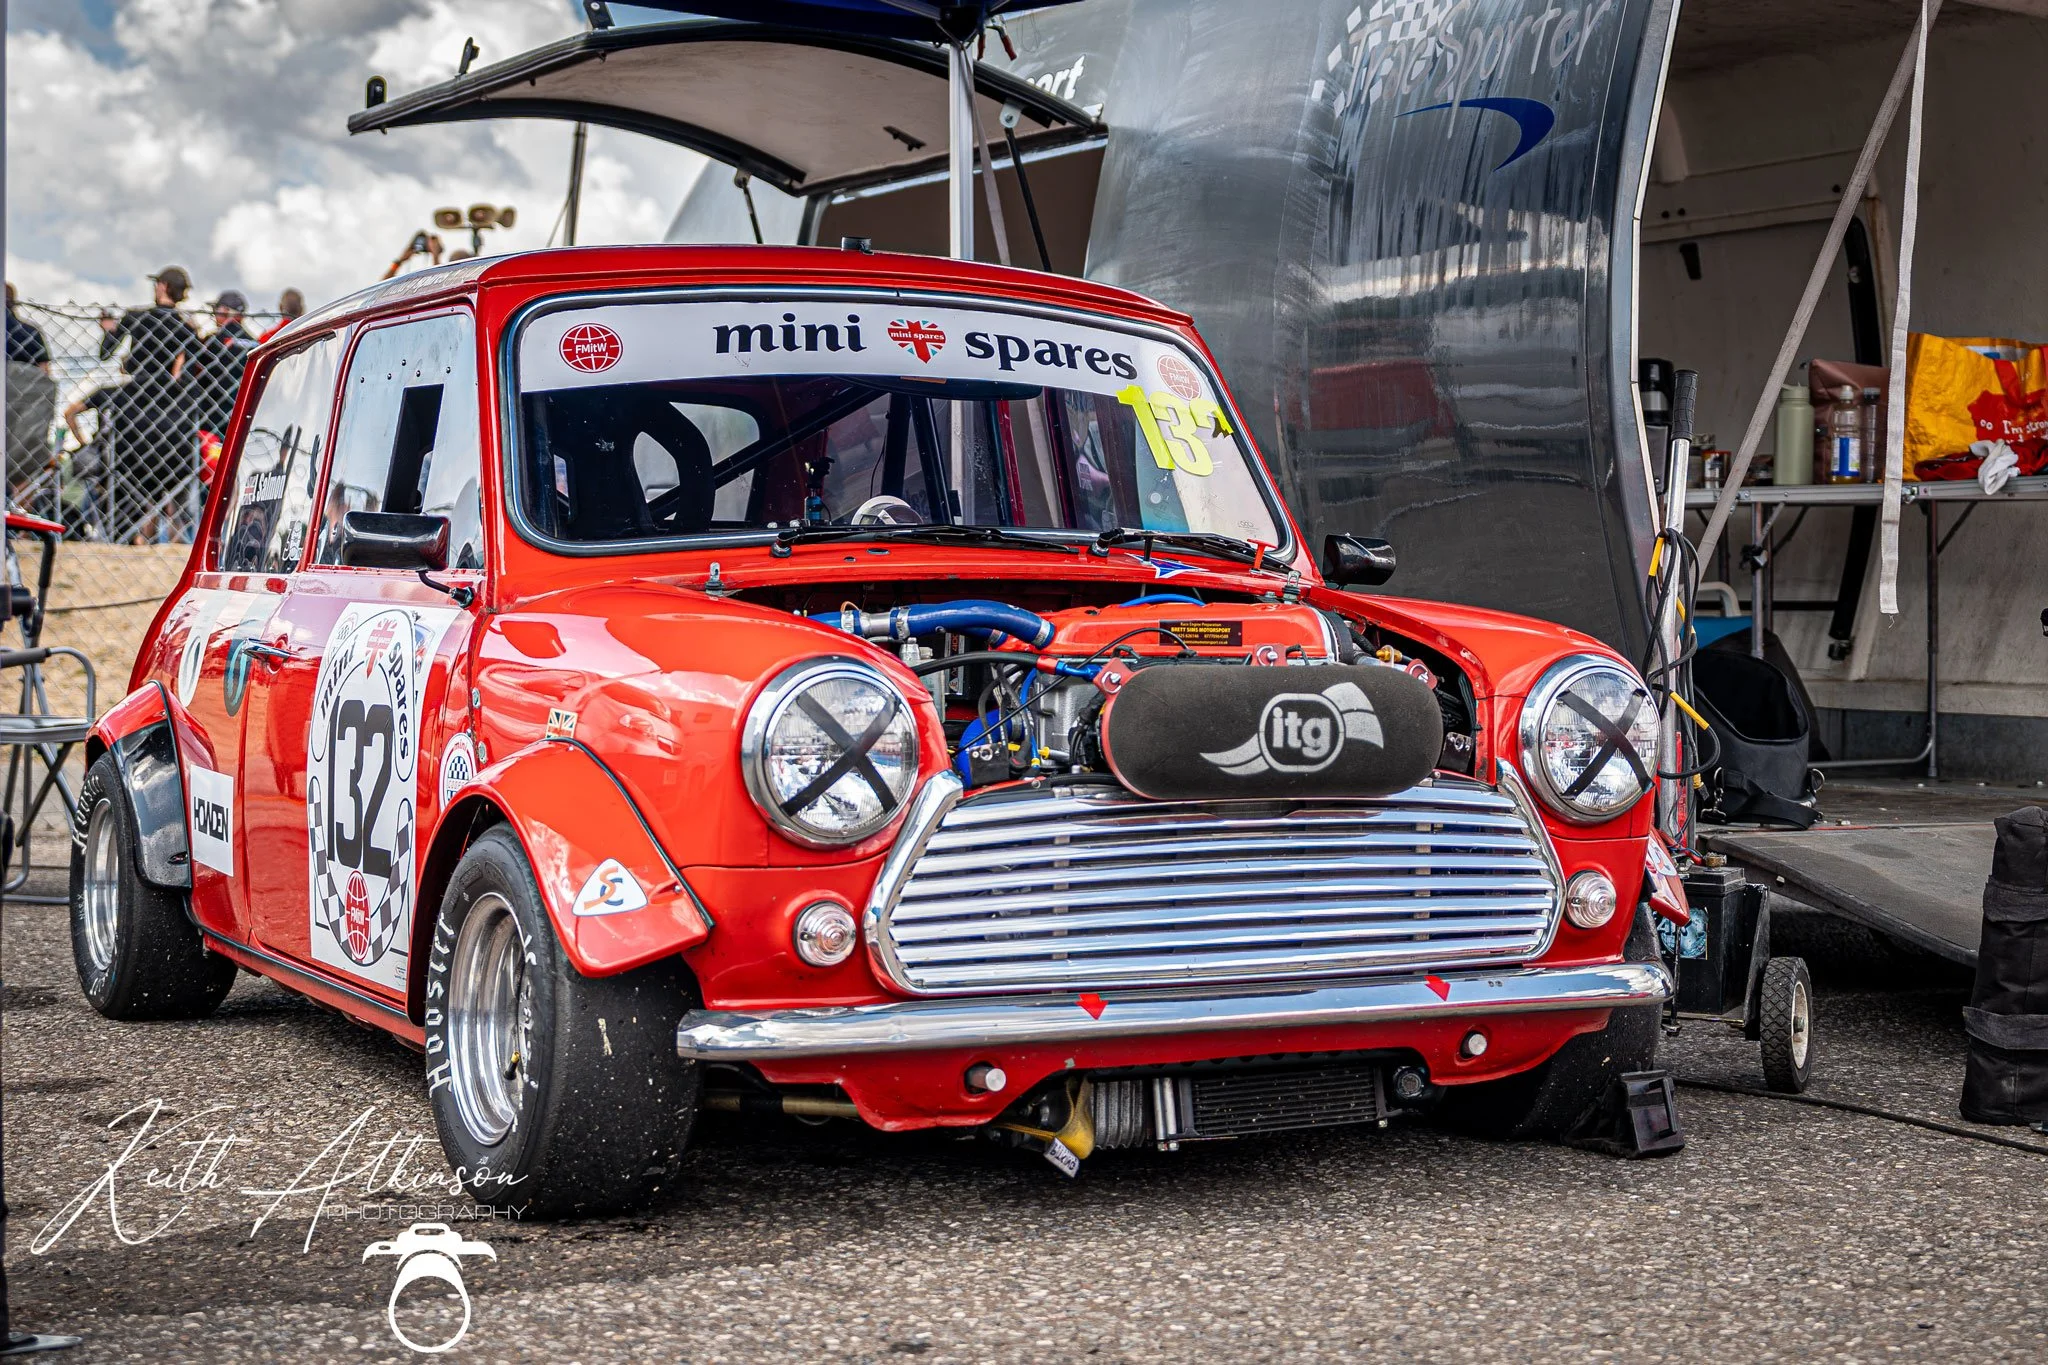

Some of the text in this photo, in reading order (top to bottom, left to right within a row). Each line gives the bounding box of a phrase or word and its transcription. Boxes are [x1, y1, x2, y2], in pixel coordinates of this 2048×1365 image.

[575, 342, 608, 355] FMitW
[712, 312, 1138, 380] mini spares
[889, 330, 945, 342] mini spares
[320, 634, 409, 761] mini spares
[1272, 706, 1331, 758] itg
[328, 695, 395, 879] 132
[193, 795, 229, 843] HOWDEN
[425, 911, 455, 1098] Hoosier
